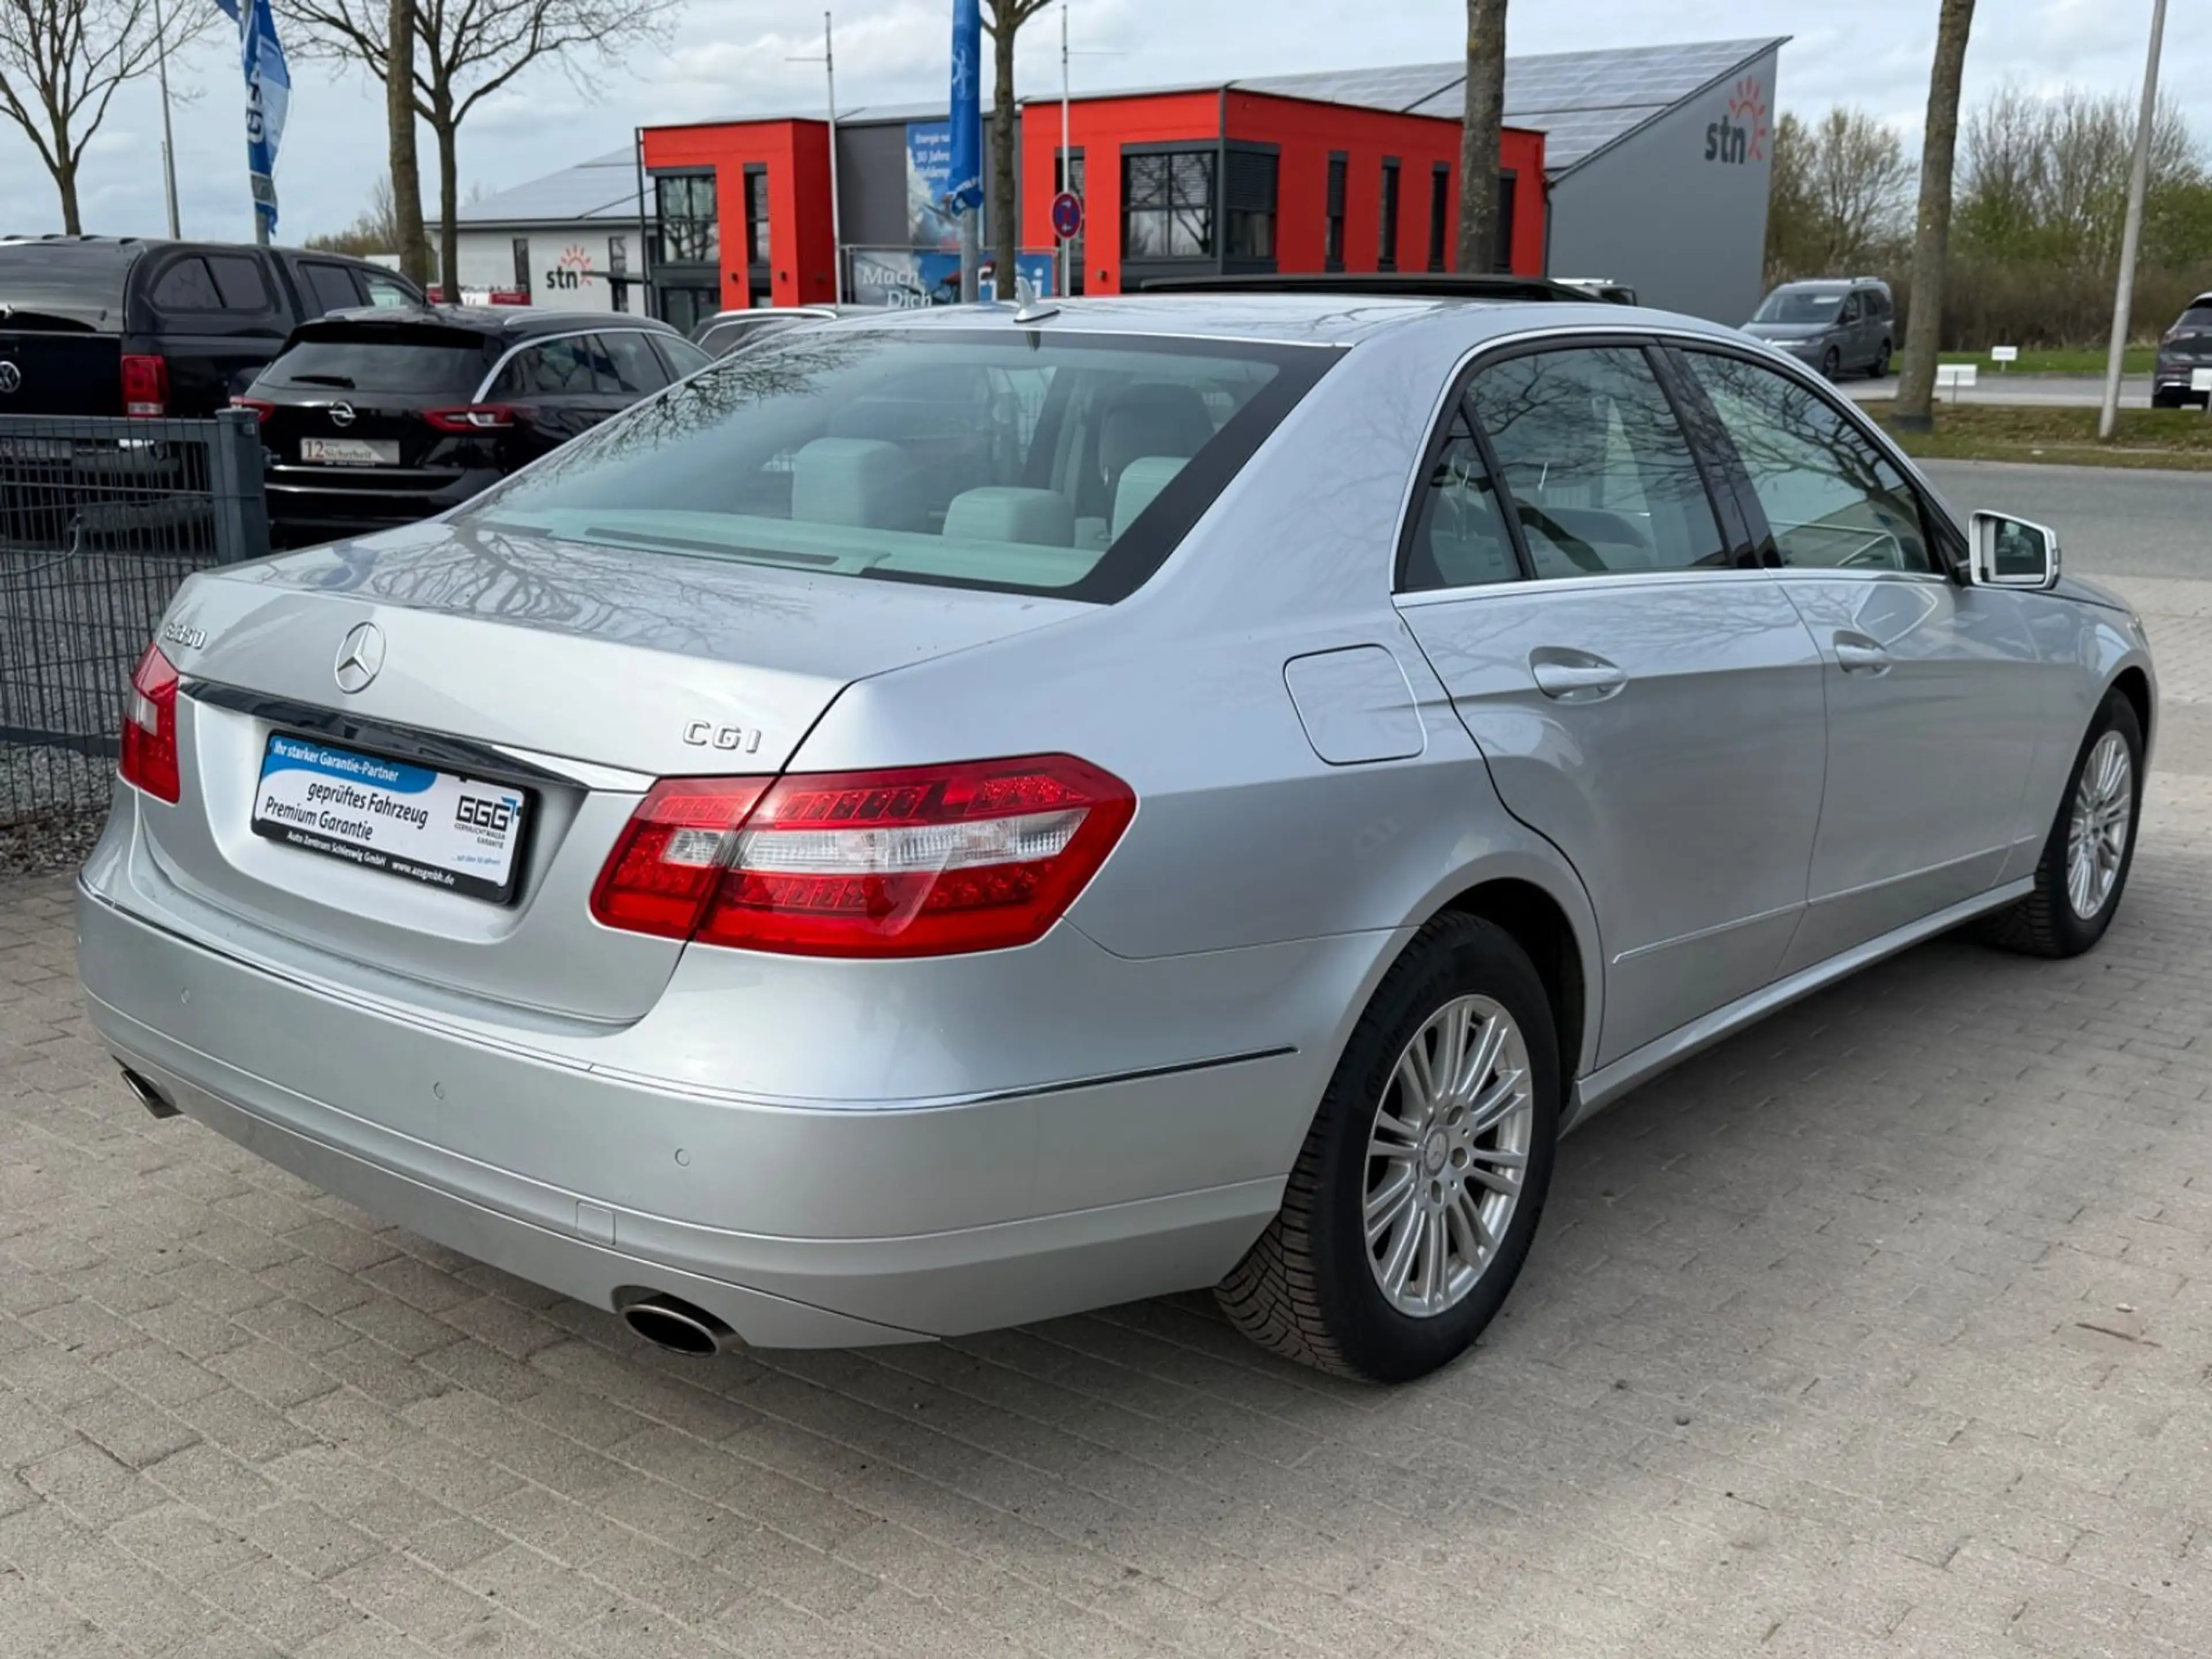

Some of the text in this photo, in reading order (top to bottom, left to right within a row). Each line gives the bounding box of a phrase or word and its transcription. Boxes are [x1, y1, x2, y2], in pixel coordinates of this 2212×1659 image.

[1705, 115, 1746, 164] stn
[546, 266, 578, 290] stn
[862, 267, 918, 285] Mach
[888, 290, 932, 307] Dich
[304, 440, 324, 458] 12
[683, 720, 762, 754] CGI
[274, 741, 399, 782] Ihr starker Garantie-Partner
[264, 796, 373, 840] Premium Garantie
[307, 782, 429, 830] geprüftes Fahrzeug
[455, 794, 508, 832] GGG
[286, 830, 304, 844] Auto
